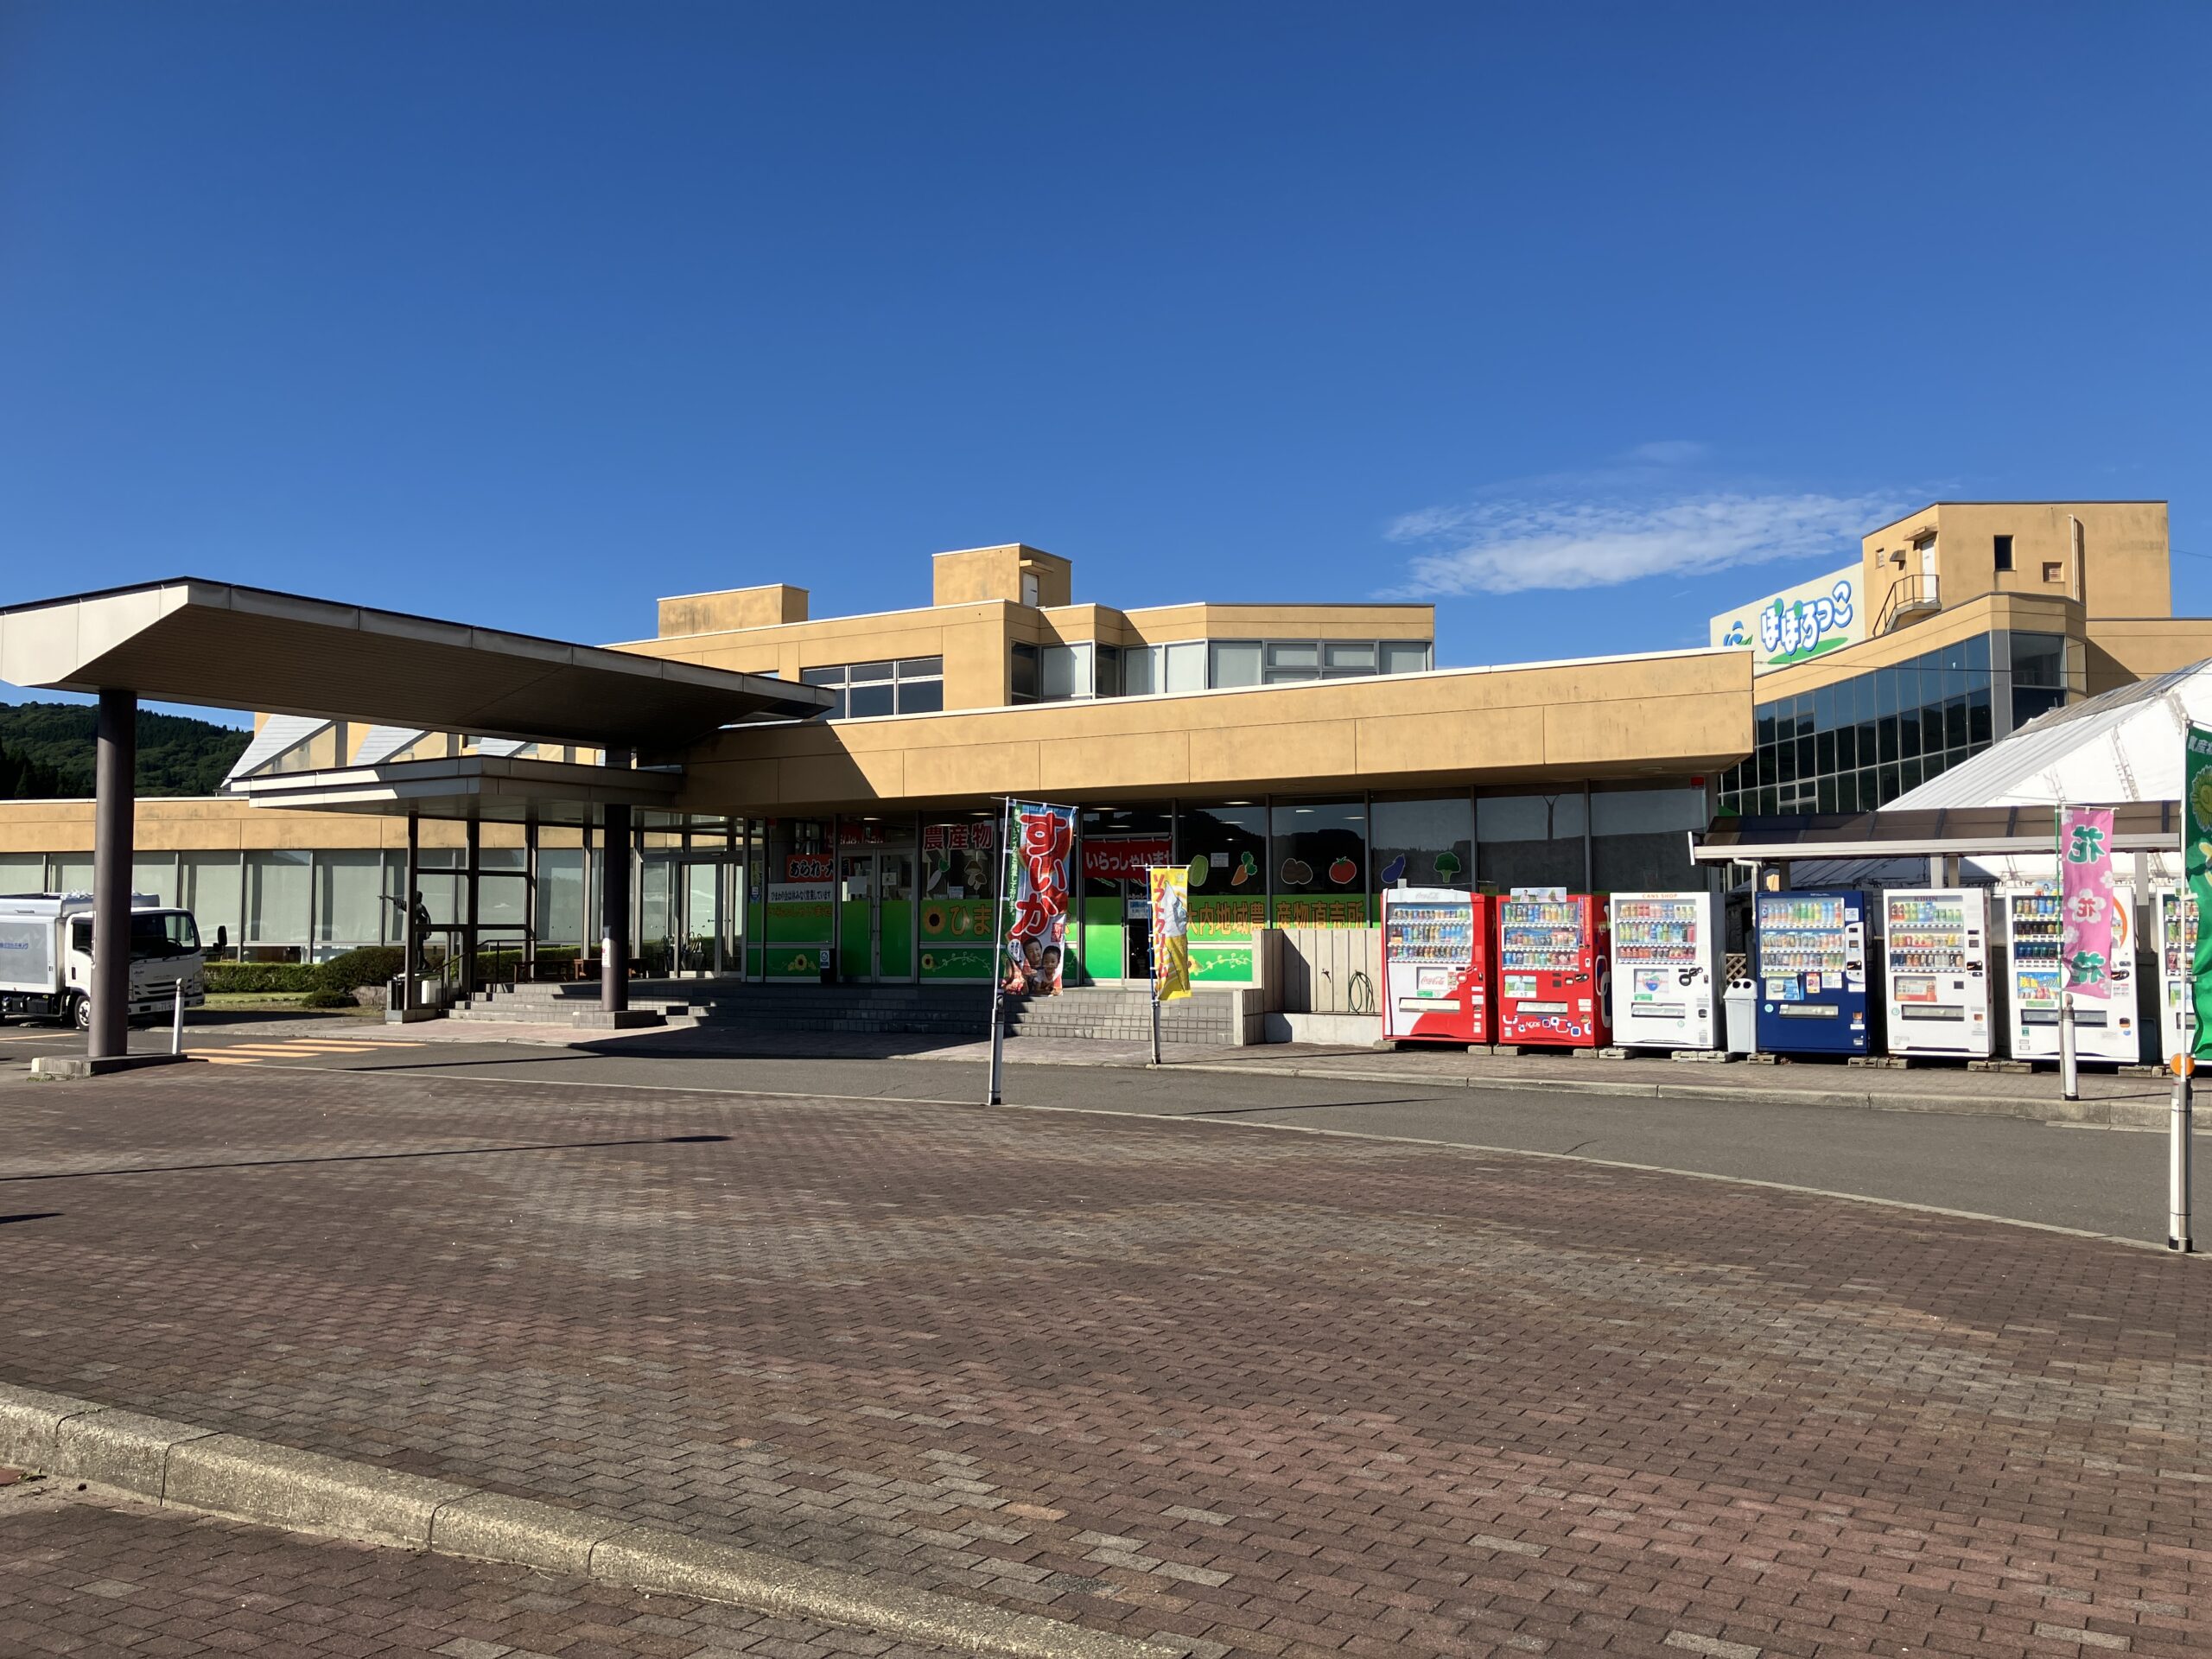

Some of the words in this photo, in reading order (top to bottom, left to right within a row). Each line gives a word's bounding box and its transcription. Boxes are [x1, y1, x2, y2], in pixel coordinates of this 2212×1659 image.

[1761, 581, 1853, 656] ぽぽろっこ
[924, 823, 994, 851] 農産物
[1011, 810, 1068, 937] すいか
[1154, 874, 1168, 978] ソフトクリーム
